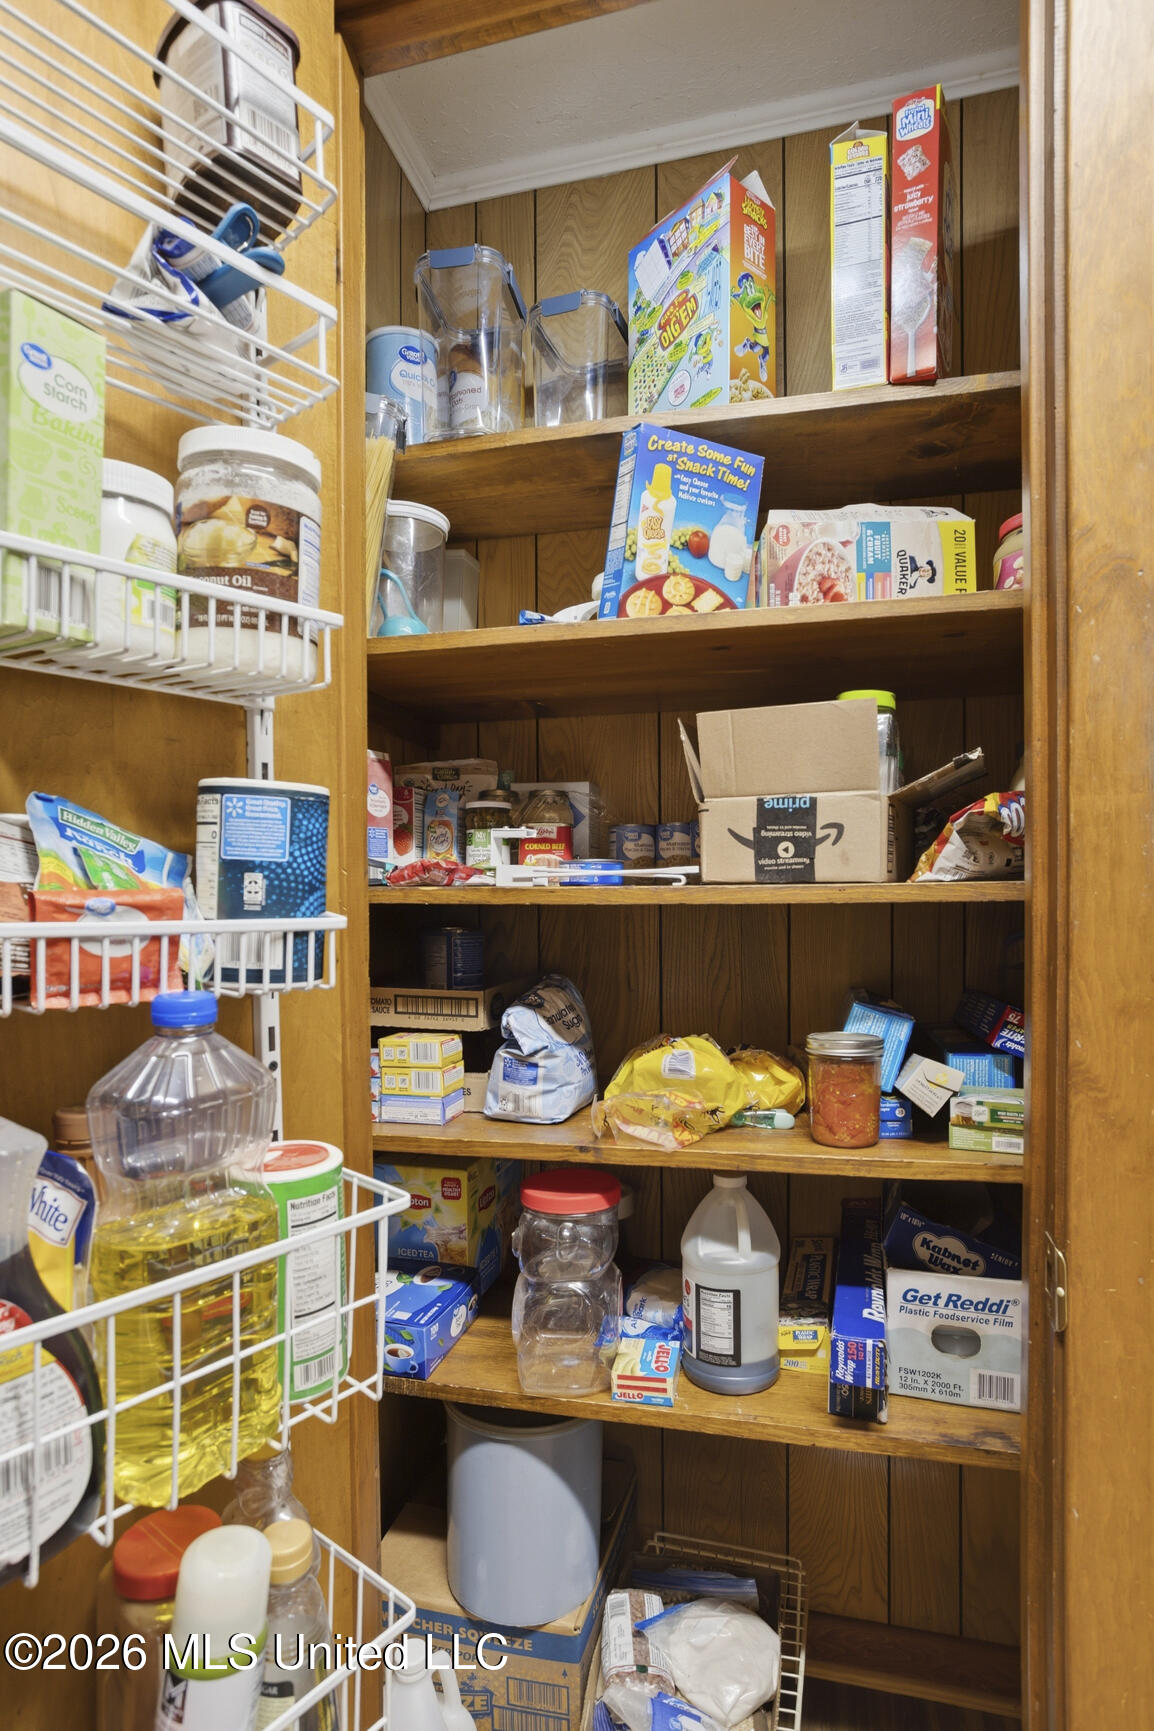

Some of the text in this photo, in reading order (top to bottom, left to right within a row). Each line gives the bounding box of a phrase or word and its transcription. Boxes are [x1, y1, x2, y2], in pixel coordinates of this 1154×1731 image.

[901, 108, 930, 127] Mini
[899, 119, 931, 138] Wheats
[893, 195, 934, 213] strawberry
[744, 244, 765, 271] BITE
[660, 295, 698, 348] DIG'EM
[54, 373, 88, 399] Corn
[43, 382, 88, 413] Starch
[647, 434, 695, 455] Create
[697, 444, 732, 465] Some
[733, 456, 756, 477] Fun
[666, 453, 751, 492] at Snack Time!
[866, 536, 874, 565] CREAM
[874, 534, 882, 560] FRUIT
[953, 529, 967, 584] 20 VALUE
[232, 575, 252, 587] Oil
[896, 549, 909, 595] QUAKER
[763, 795, 811, 812] prime
[62, 811, 136, 853] Hidden Valley
[760, 829, 813, 839] video streaming
[525, 842, 551, 851] CORNED
[371, 997, 392, 1006] OMATO
[371, 1005, 391, 1014] SAUCE
[562, 1014, 583, 1030] Suga
[1007, 1013, 1021, 1024] 75
[290, 1197, 321, 1211] Nutrition
[397, 1247, 435, 1259] ICED TEA
[920, 1237, 980, 1271] Kabnet
[927, 1253, 963, 1275] Wax
[636, 1295, 648, 1319] Bark
[902, 1288, 942, 1307] Get
[899, 1305, 1014, 1328] Plastic Foodservice Film
[835, 1339, 846, 1380] Reynolds
[848, 1341, 857, 1361] 150
[783, 1359, 800, 1368] 200
[844, 1359, 857, 1384] Wrap
[898, 1367, 942, 1380] FSW1202K
[899, 1375, 909, 1383] 12
[931, 1380, 951, 1390] 2000
[953, 1383, 964, 1392] Ft.
[899, 1382, 928, 1393] 305mm
[938, 1388, 961, 1398] 610m
